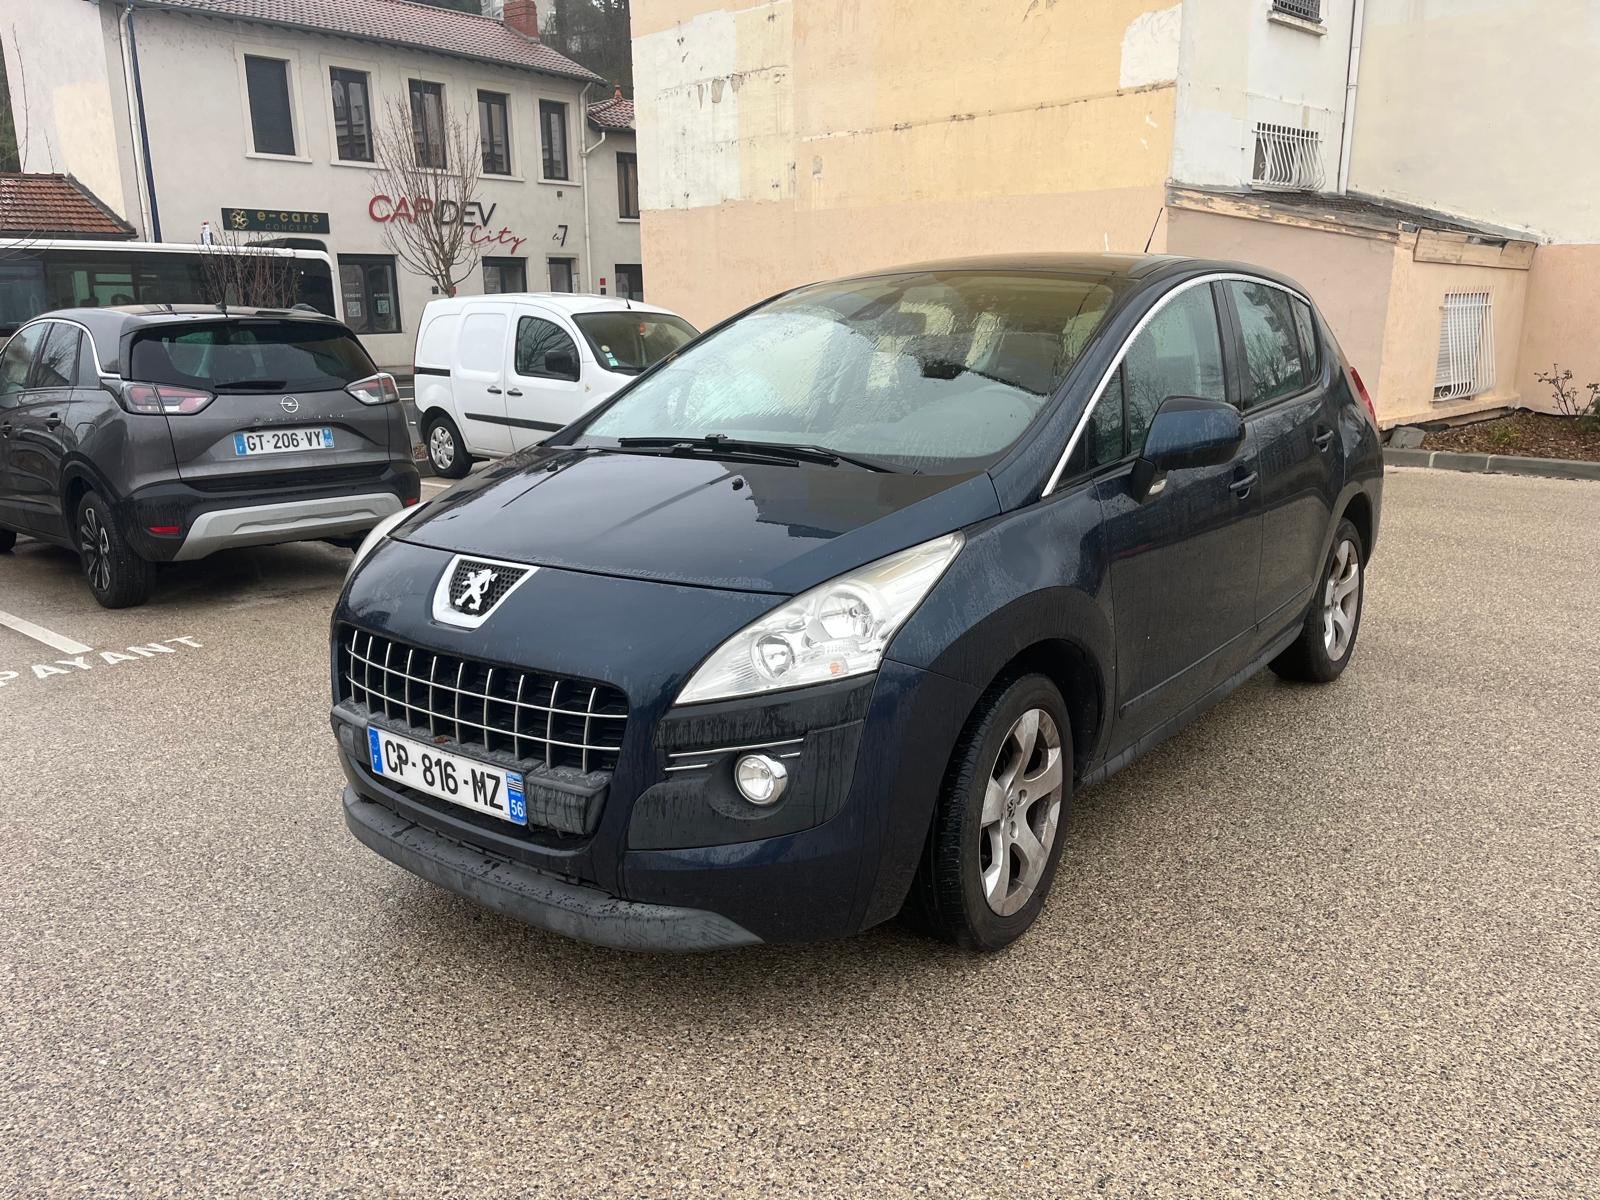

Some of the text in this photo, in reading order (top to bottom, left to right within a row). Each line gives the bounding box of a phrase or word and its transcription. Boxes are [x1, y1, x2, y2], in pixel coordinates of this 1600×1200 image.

[256, 211, 321, 224] e-cars
[265, 223, 313, 232] CONCEPT
[470, 224, 528, 255] City
[558, 224, 569, 247] 7
[246, 430, 321, 452] GT-206-VY
[384, 739, 504, 811] CP-816-MZ
[510, 799, 524, 818] 56
